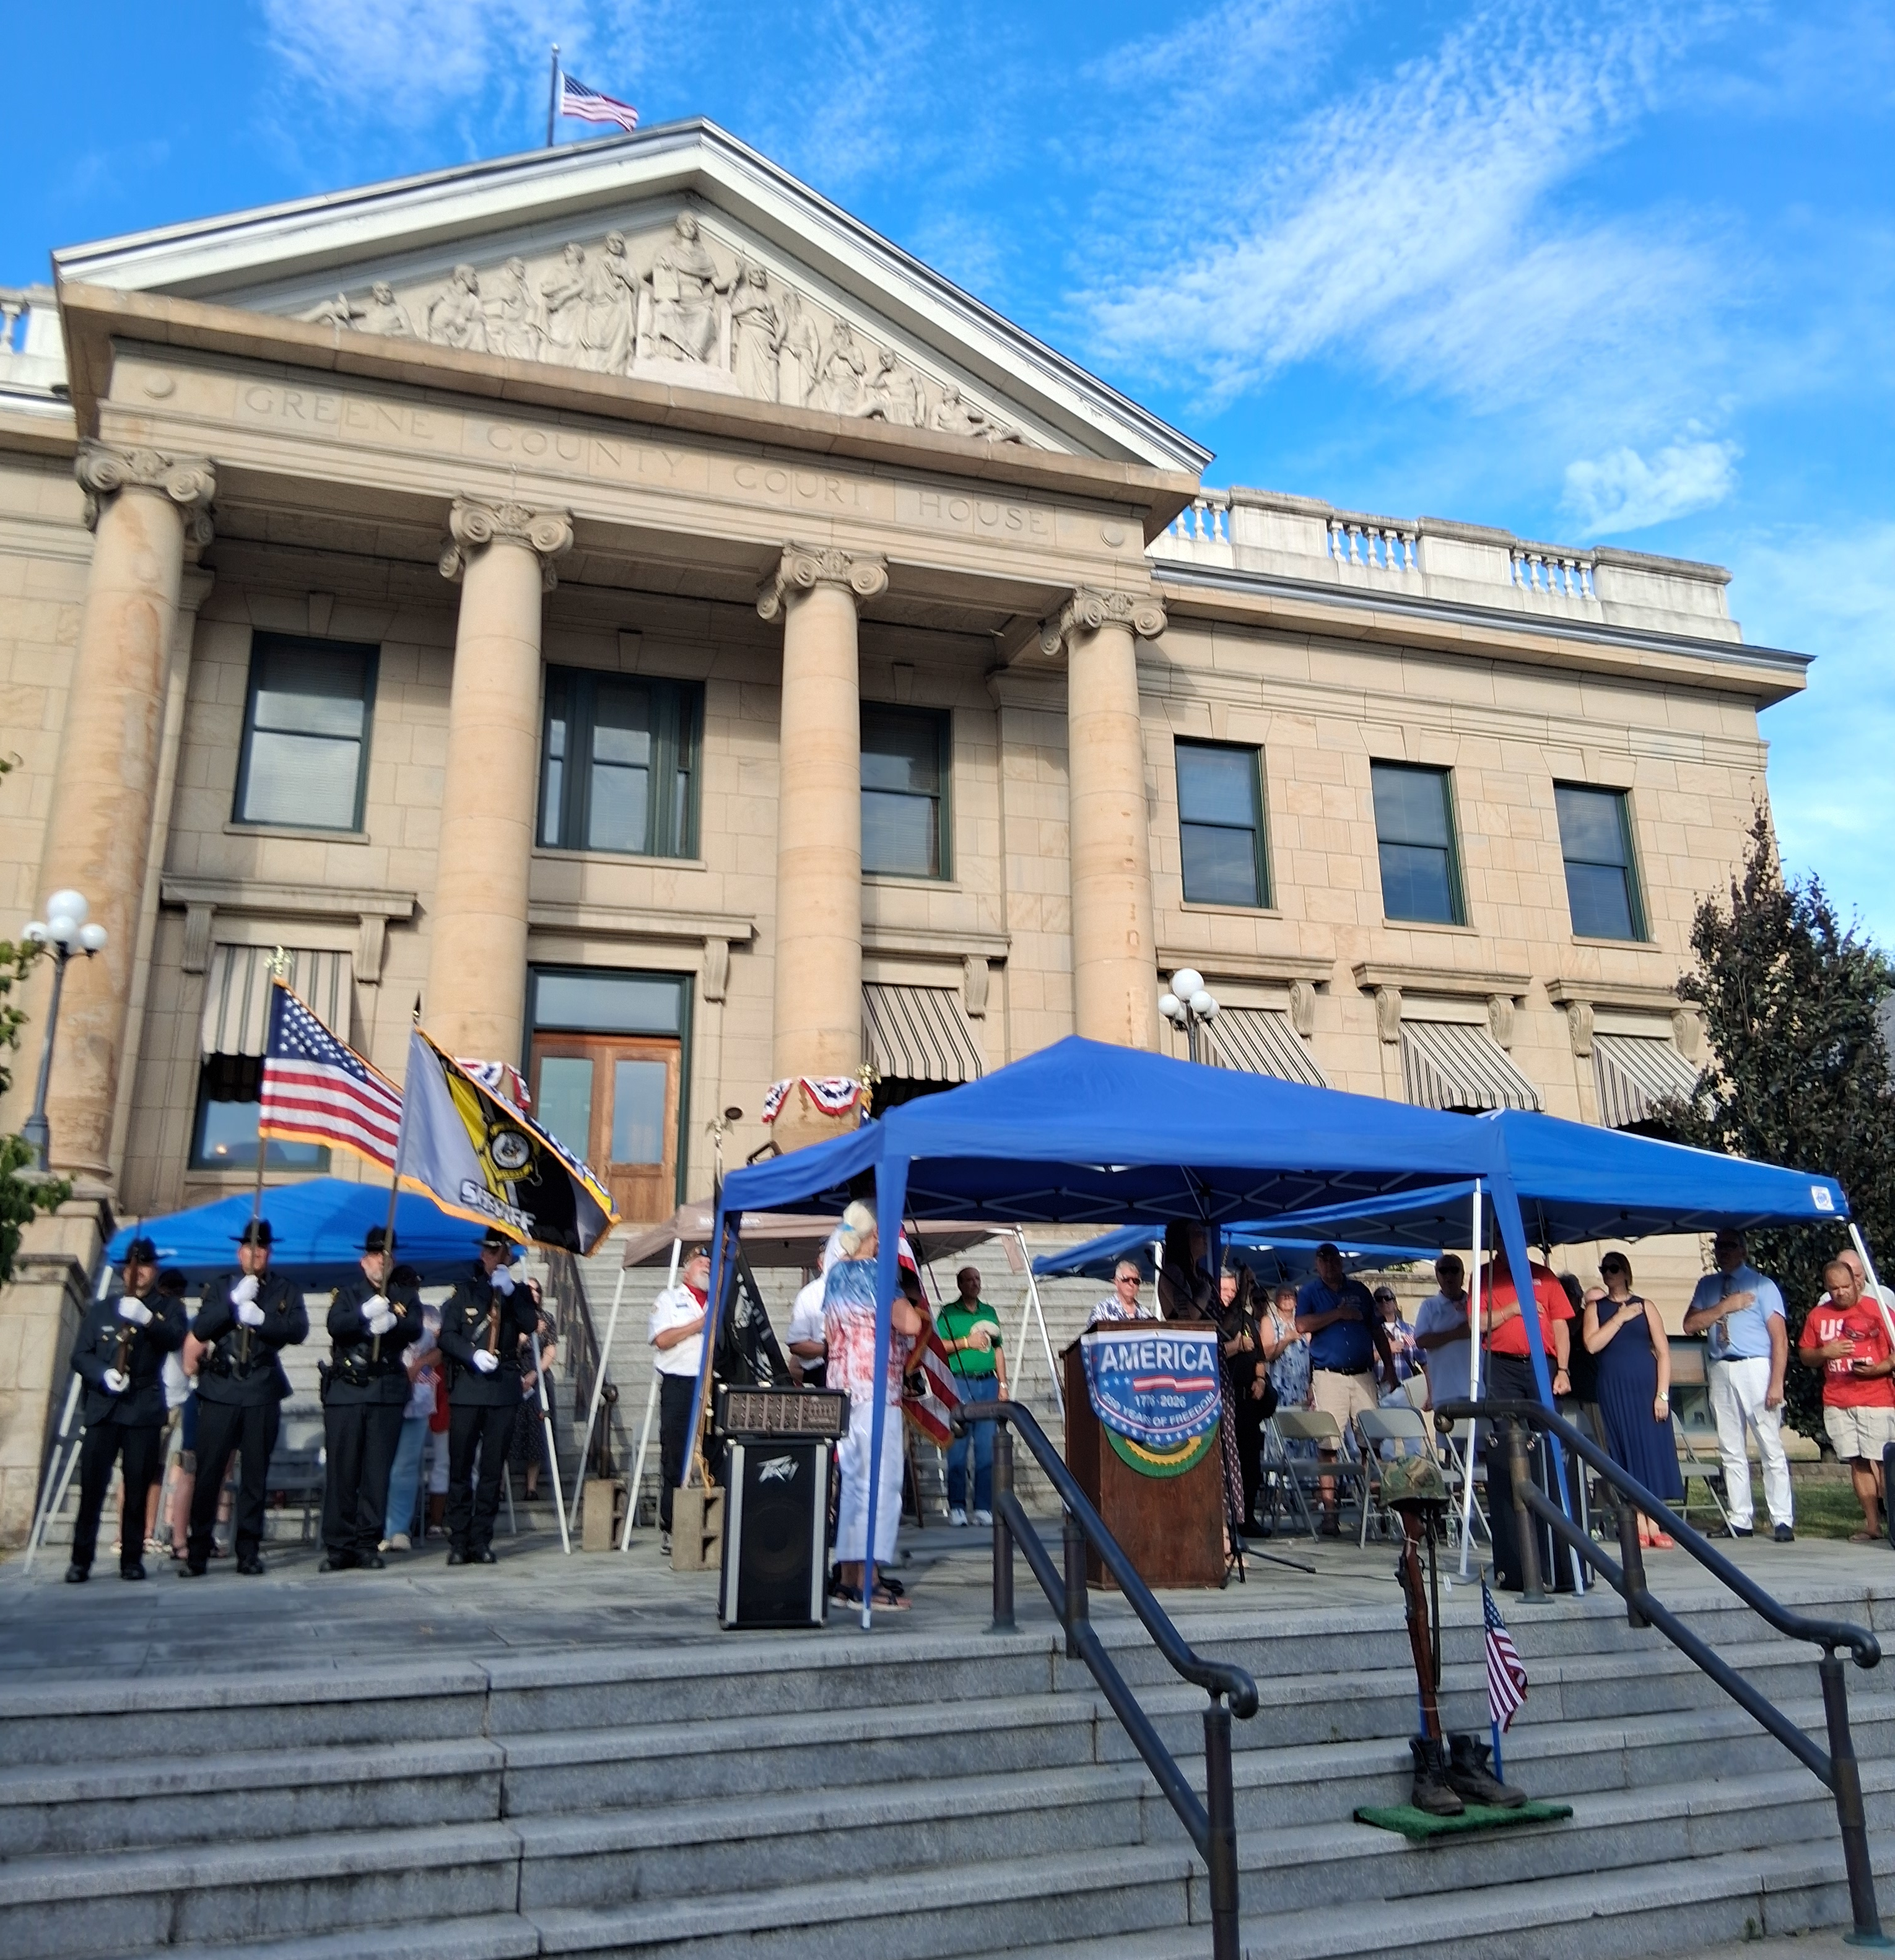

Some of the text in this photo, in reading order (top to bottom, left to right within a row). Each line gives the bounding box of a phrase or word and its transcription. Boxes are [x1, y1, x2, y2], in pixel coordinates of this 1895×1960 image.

[244, 386, 1049, 536] GREENE COUNTY COURT HOUSE
[1100, 1341, 1215, 1373] AMERICA
[1152, 1416, 1167, 1427] OF
[1169, 1390, 1215, 1427] FREEDOM
